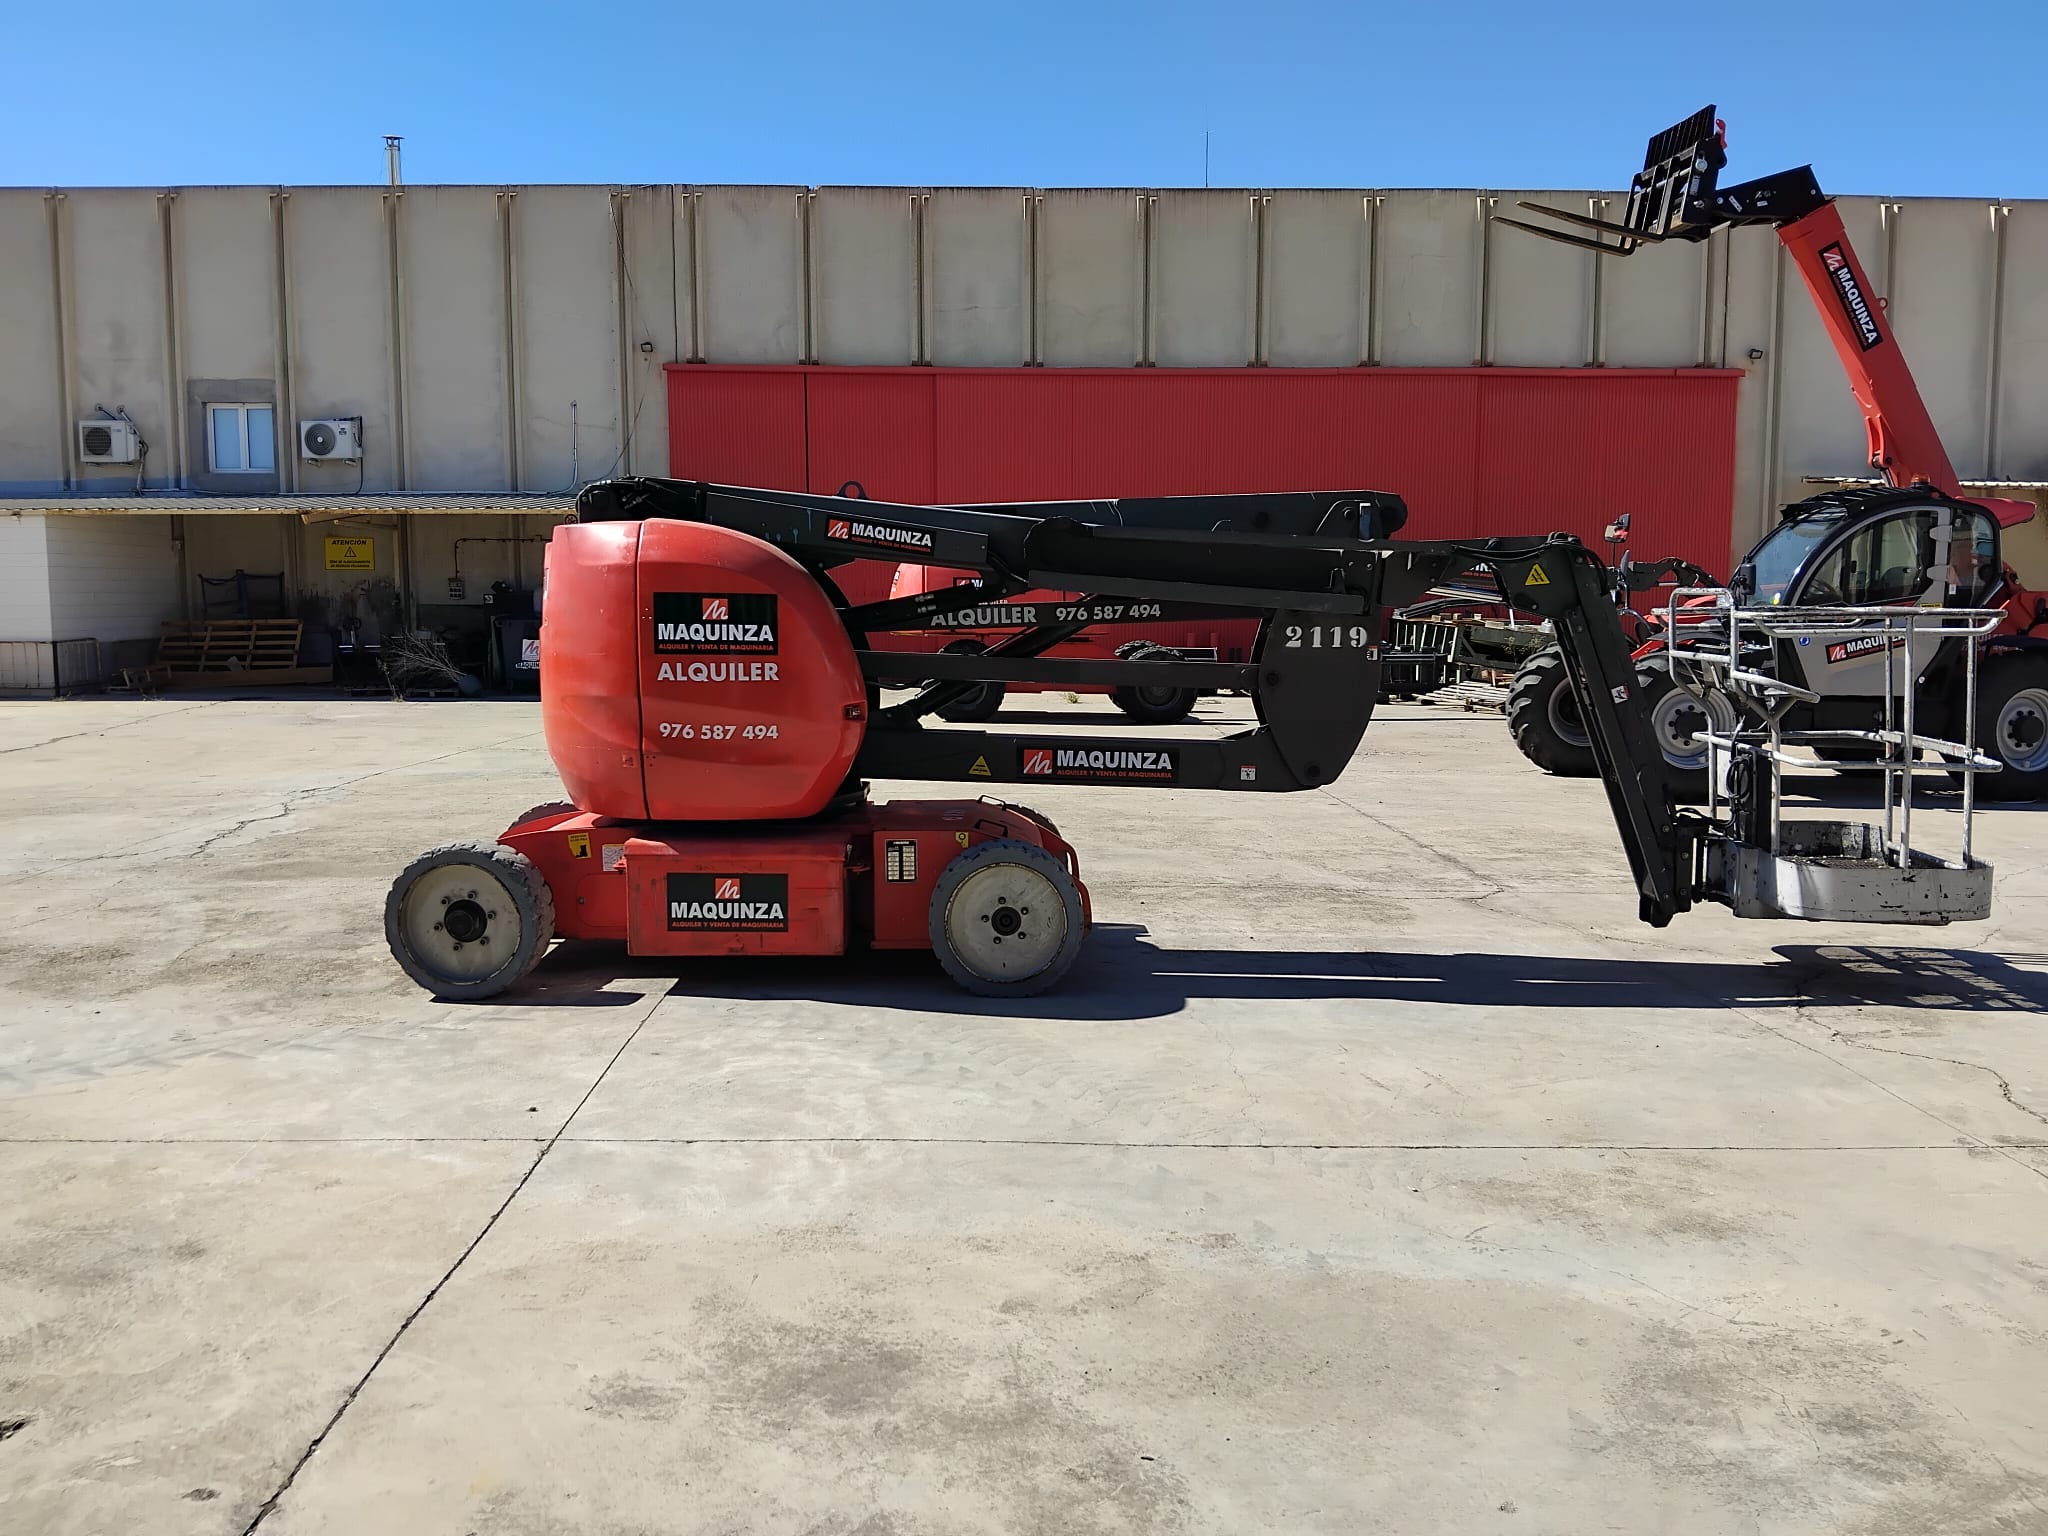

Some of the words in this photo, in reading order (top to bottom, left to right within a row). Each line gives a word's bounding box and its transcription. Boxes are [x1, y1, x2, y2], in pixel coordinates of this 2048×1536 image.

[1837, 267, 1878, 343] MAQUINZA
[851, 522, 932, 547] MAQUINZA
[931, 607, 1037, 626] ALQUILER
[1056, 607, 1088, 621] 976
[1093, 605, 1124, 620] 587
[1129, 604, 1161, 618] 494
[658, 623, 774, 642] MAQUINZA
[1285, 626, 1367, 648] 2119
[657, 662, 780, 682] ALQUILER
[659, 722, 695, 739] 976
[700, 725, 737, 740] 587
[742, 725, 779, 740] 494
[1057, 750, 1173, 770] MAQUINZA
[1057, 769, 1088, 777] ALQUILER
[671, 902, 784, 920] MAQUINZA
